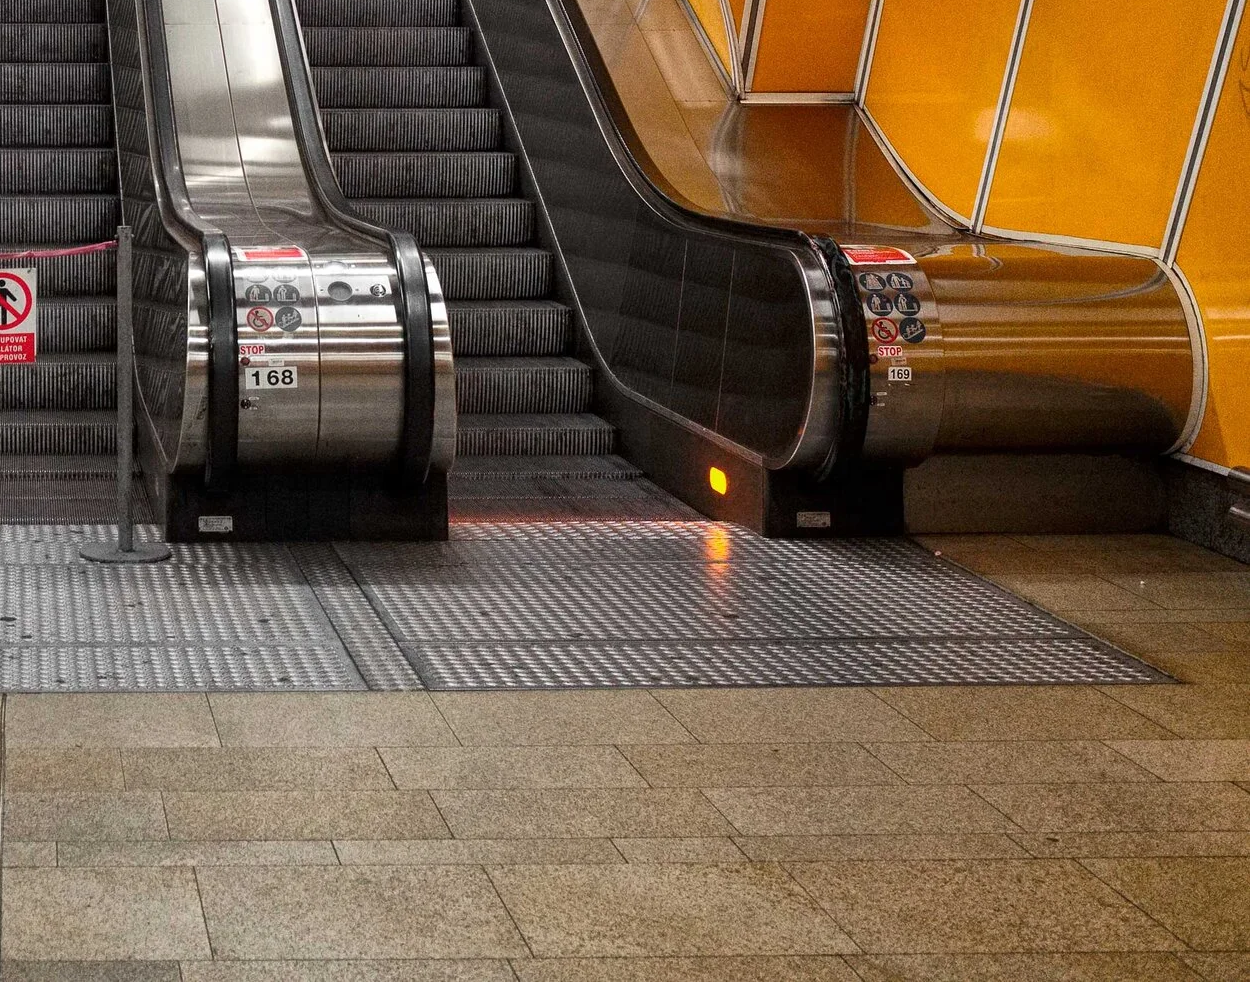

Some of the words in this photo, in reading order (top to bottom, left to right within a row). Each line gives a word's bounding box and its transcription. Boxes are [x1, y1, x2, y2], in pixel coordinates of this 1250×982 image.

[240, 345, 264, 355] STOP
[878, 347, 902, 356] STOP
[0, 353, 27, 361] PROVOZ
[251, 369, 294, 386] 168
[890, 368, 910, 379] 169
